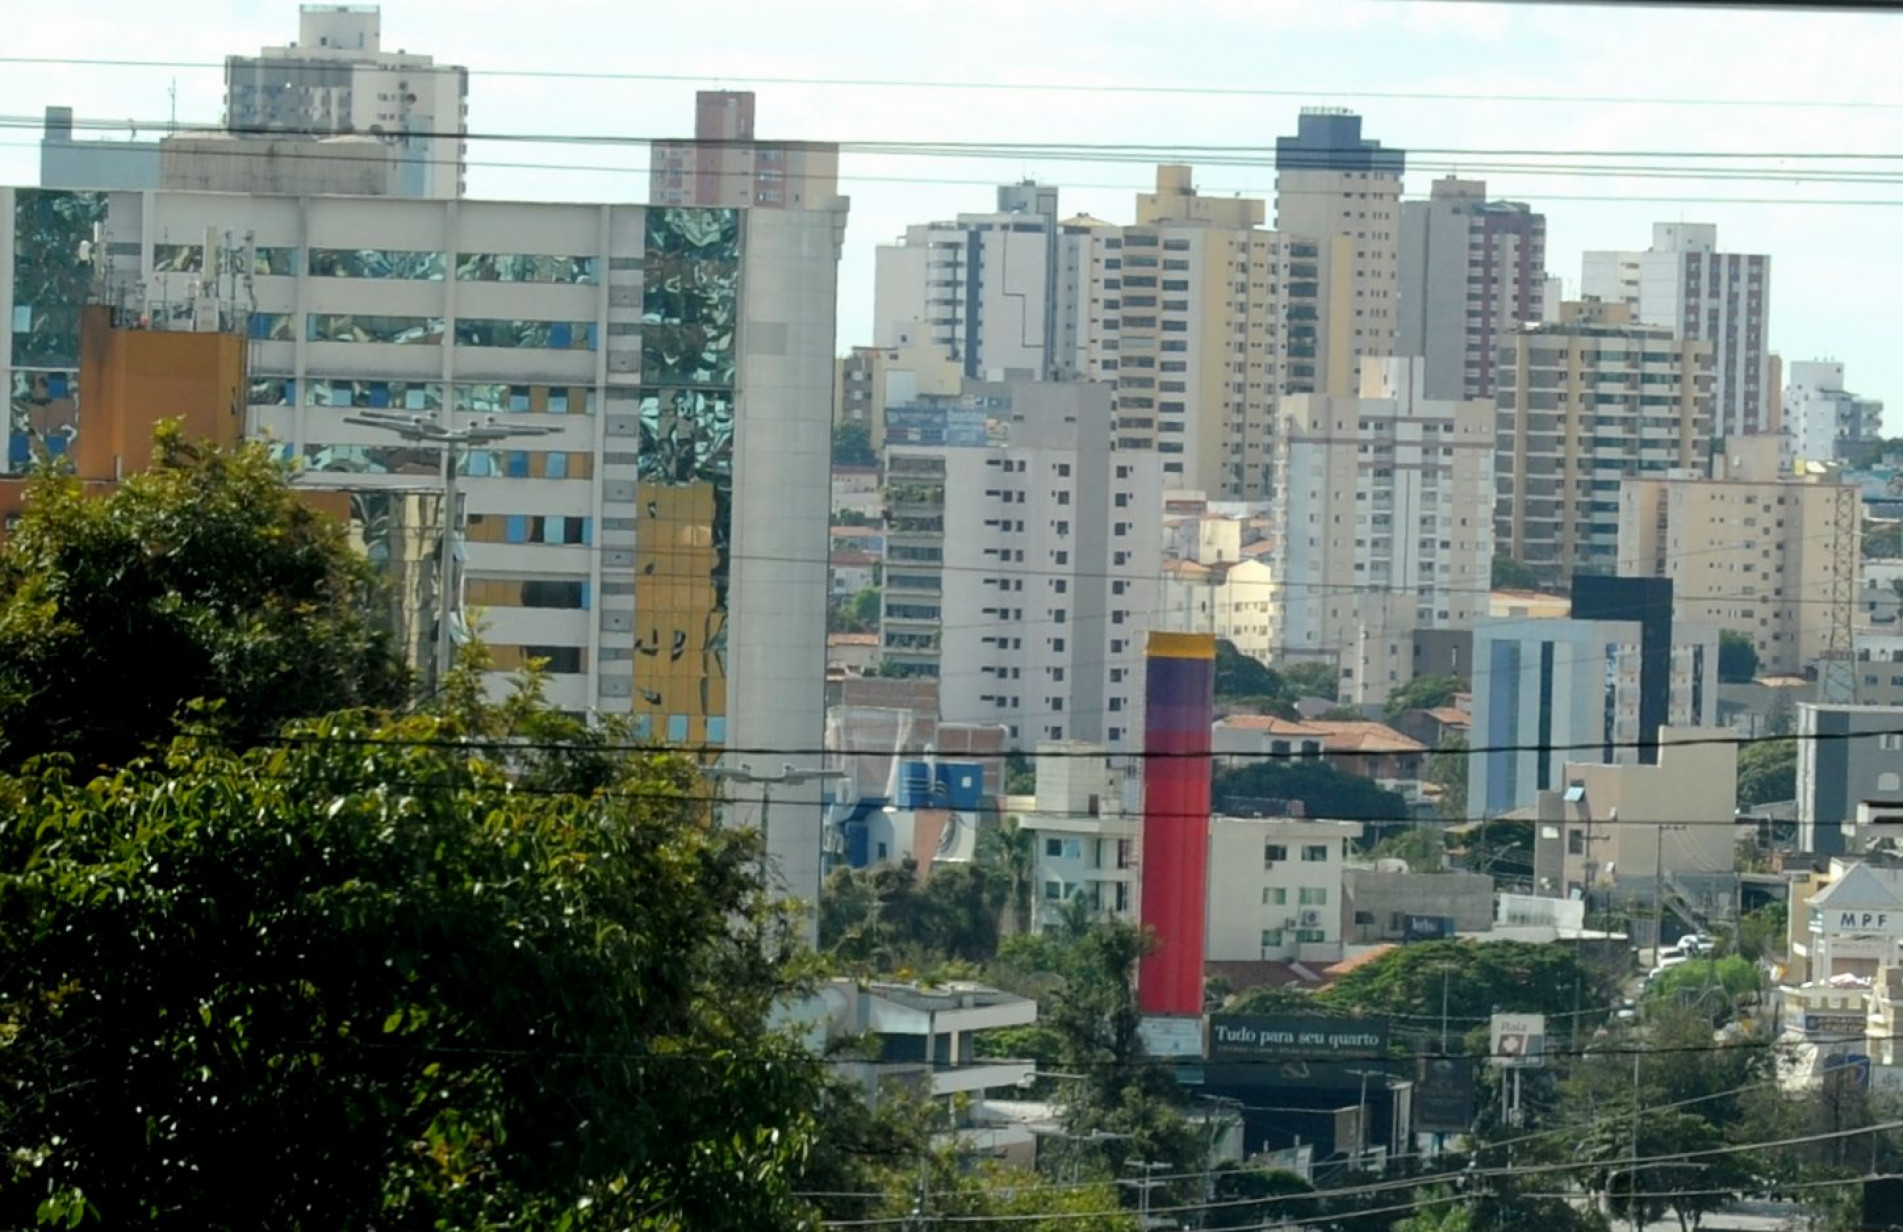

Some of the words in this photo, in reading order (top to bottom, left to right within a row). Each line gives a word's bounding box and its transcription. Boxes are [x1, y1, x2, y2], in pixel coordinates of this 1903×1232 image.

[1840, 913, 1887, 927] MPF
[1215, 1025, 1256, 1042] Tudo
[1260, 1031, 1294, 1046] para
[1298, 1033, 1325, 1044] seu
[1329, 1033, 1379, 1048] quarto
